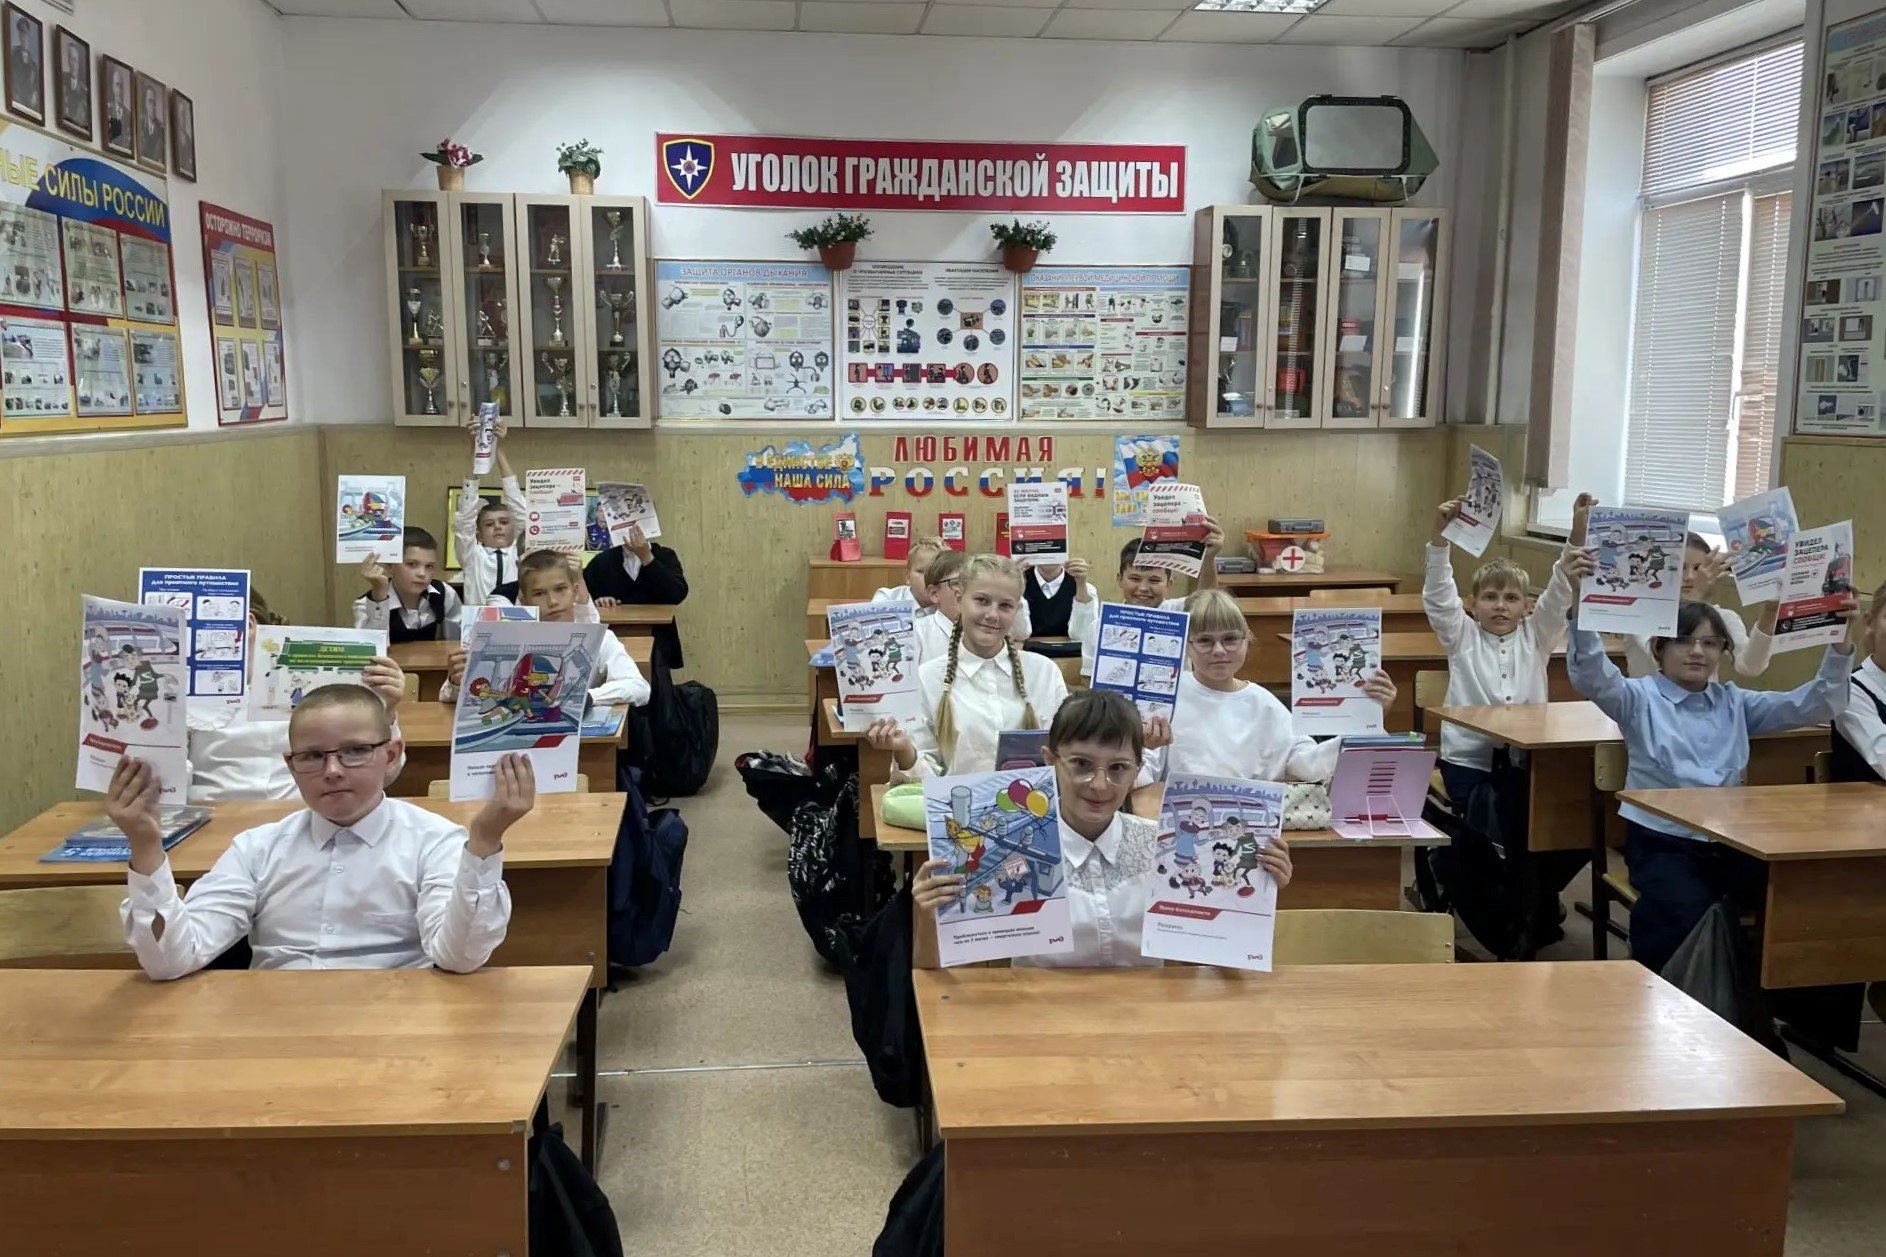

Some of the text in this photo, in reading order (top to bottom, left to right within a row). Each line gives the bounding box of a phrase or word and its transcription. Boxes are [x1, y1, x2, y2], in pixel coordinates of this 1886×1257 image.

[731, 151, 1178, 204] УГОЛОК ГРАЖДАНСКОЙ ЗАЩИТЫ
[44, 163, 99, 208] СИЛЫ
[102, 183, 166, 228] РОССИИ
[205, 212, 242, 238] ОСТОРОЖНО
[680, 267, 807, 279] ЗАЩИТА ОРГАНОВ ДЫХАНИЯ
[894, 435, 1054, 463] ЛЮБИМАЯ
[775, 473, 851, 489] НАША СИЛА
[1794, 537, 1823, 548] УВИДЕЛ
[1794, 544, 1829, 557] ЗАЦЕПЕРА
[1145, 613, 1171, 621] ПРАВИЛА
